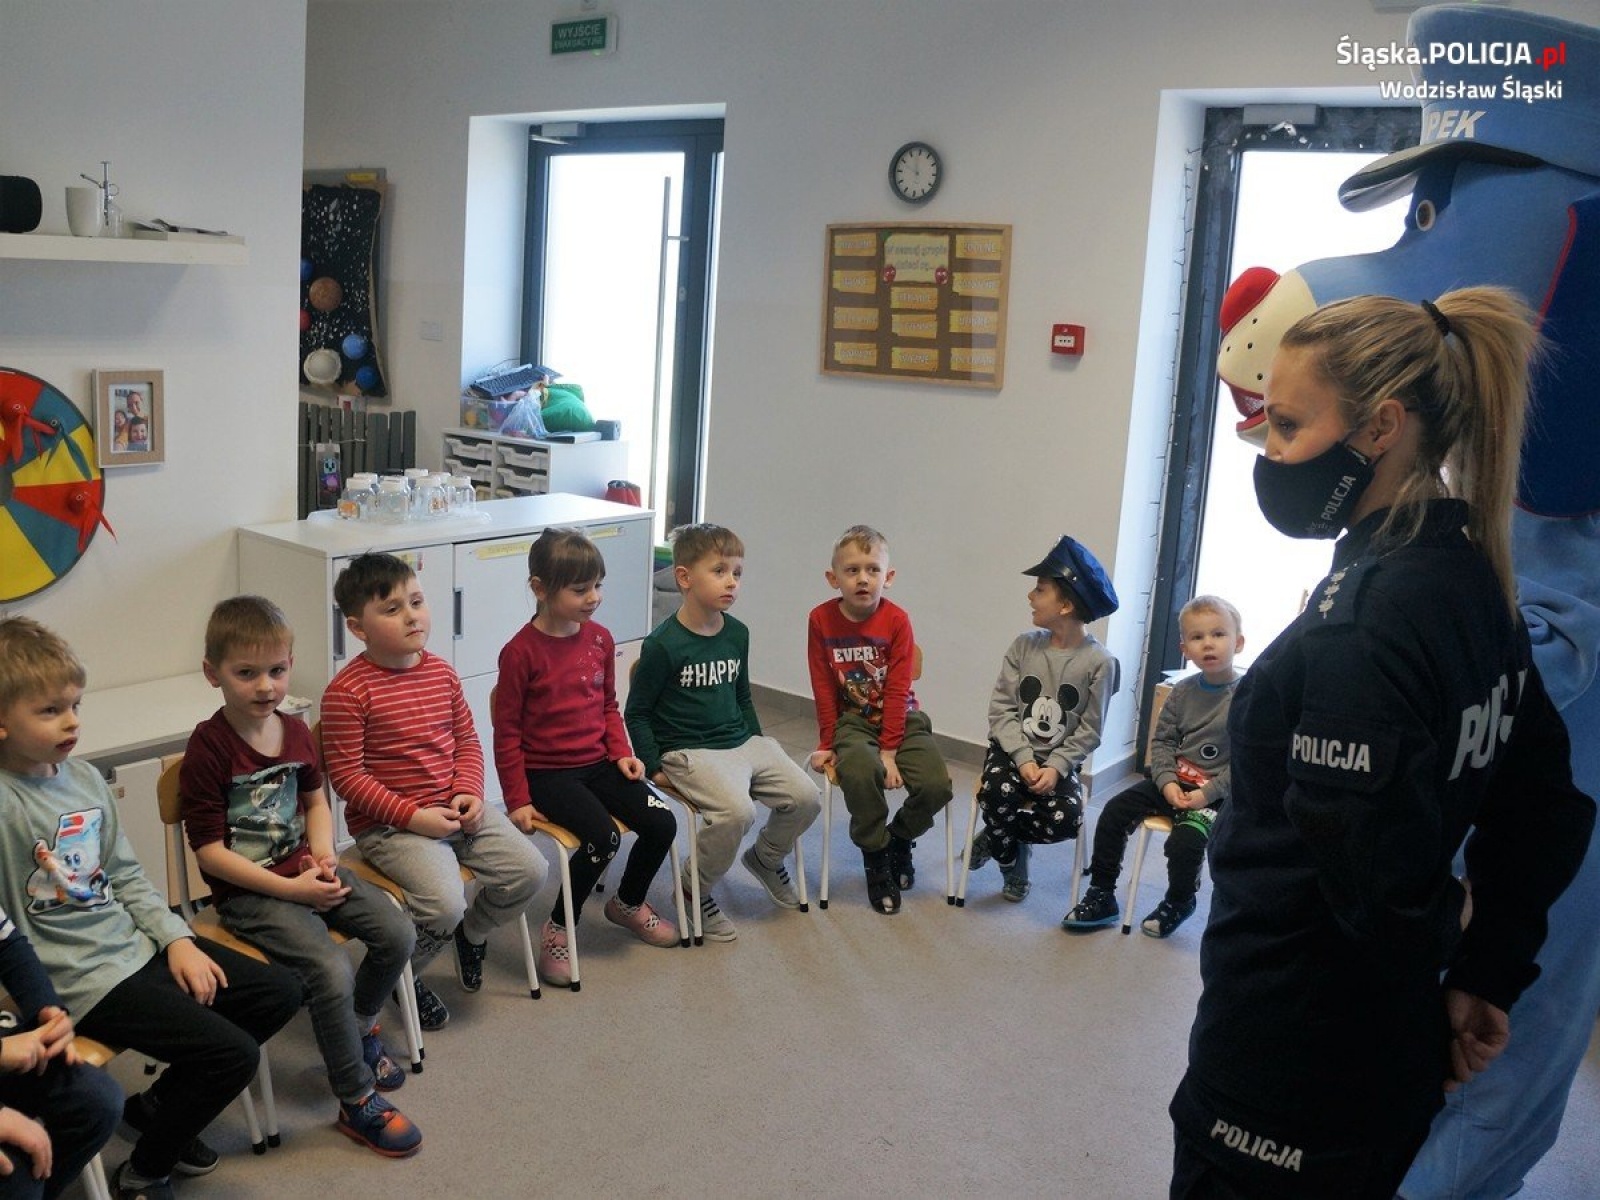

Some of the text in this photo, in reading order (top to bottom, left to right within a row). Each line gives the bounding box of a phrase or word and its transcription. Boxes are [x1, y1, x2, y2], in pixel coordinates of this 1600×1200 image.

[1320, 475, 1357, 521] POLICJA
[832, 646, 880, 664] EVER!
[1292, 733, 1371, 773] POLICJA
[1210, 1118, 1303, 1172] POLICJA
